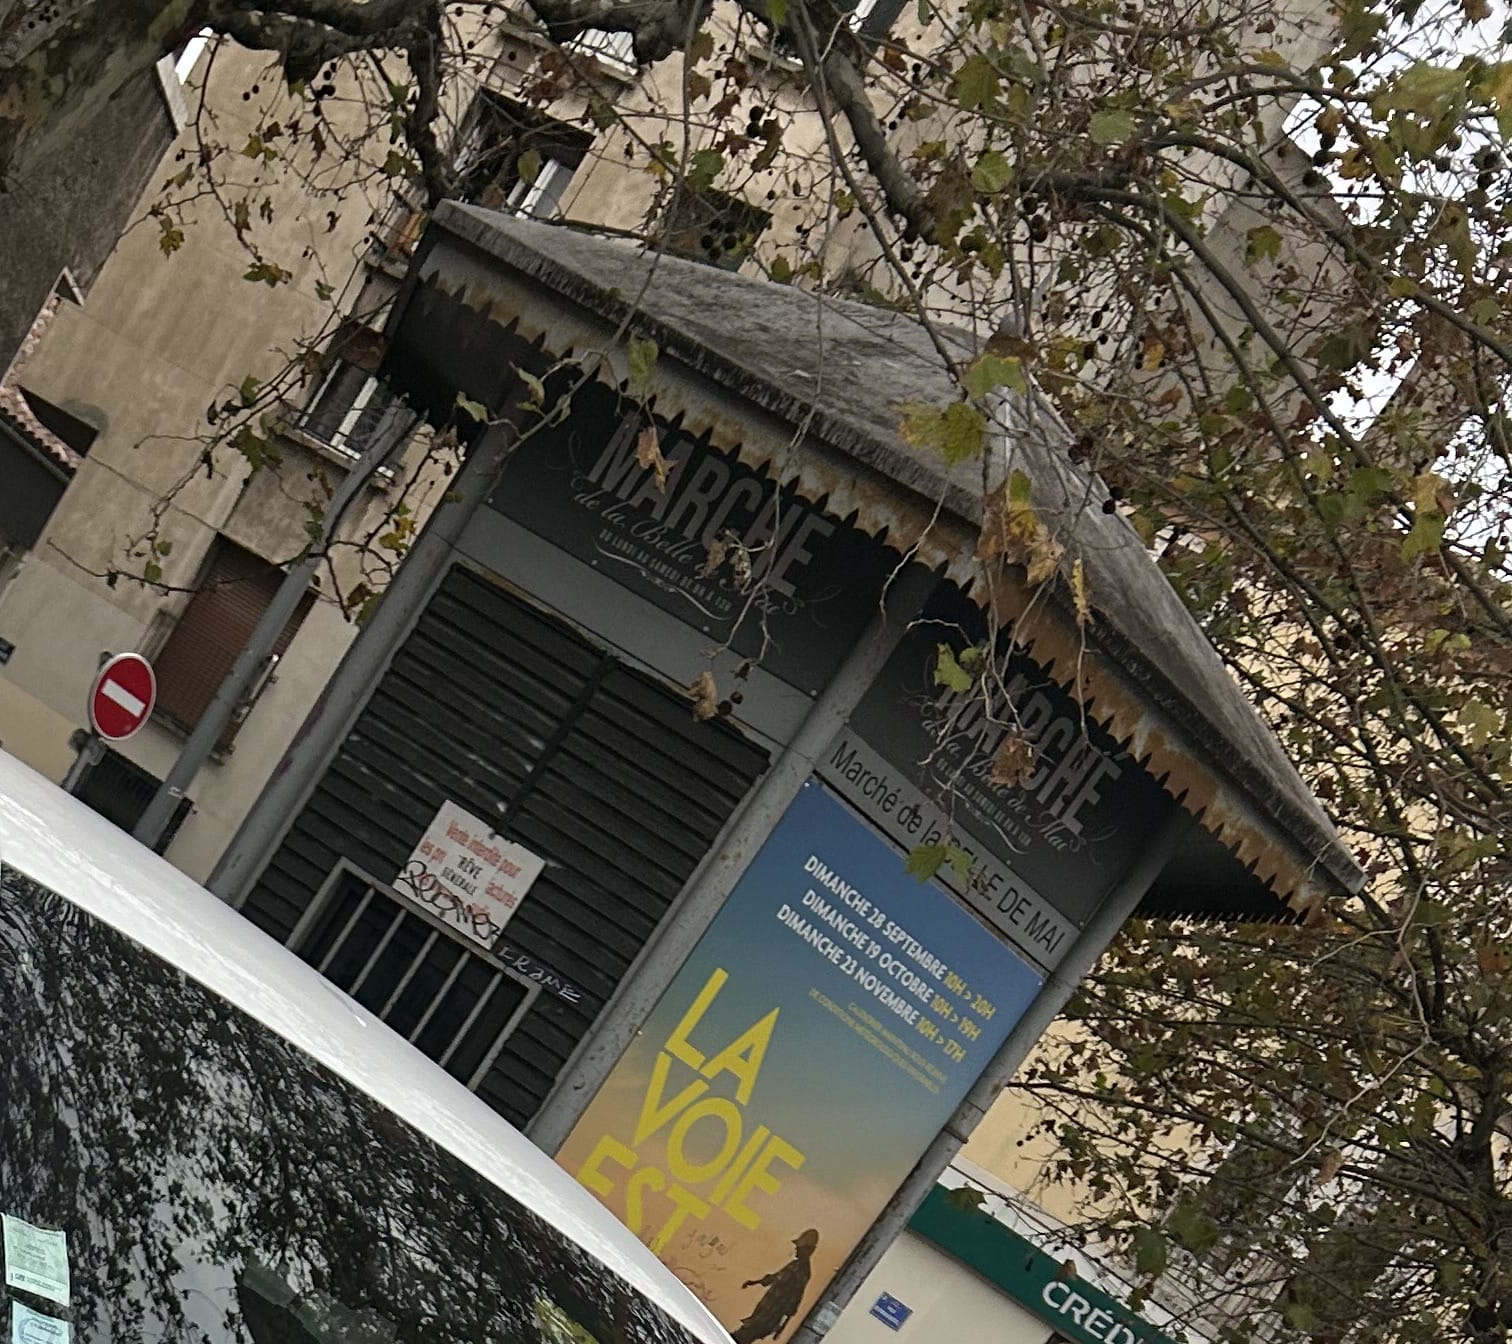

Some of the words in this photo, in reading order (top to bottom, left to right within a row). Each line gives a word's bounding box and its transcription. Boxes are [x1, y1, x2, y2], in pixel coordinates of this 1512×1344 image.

[830, 741, 902, 814] Marché
[897, 801, 924, 835] de
[920, 820, 943, 850] la
[997, 888, 1033, 926] DE
[1024, 909, 1066, 956] MAI
[776, 904, 845, 965] DIMANCHE
[839, 953, 859, 976] 23
[854, 967, 921, 1026] NOVEMBRE
[915, 1016, 940, 1041] 10H
[943, 1039, 967, 1064] 17H
[802, 889, 870, 951] DIMANCHE
[864, 940, 882, 960] 19
[878, 952, 935, 1004] OCTOBRE
[929, 993, 954, 1019] 10H
[804, 856, 873, 917] DIMANCHE
[867, 908, 887, 929] 28
[882, 921, 948, 981] SEPTEMBRE
[943, 971, 968, 996] 10H
[664, 967, 781, 1106] LA
[632, 1051, 807, 1231] VOIE
